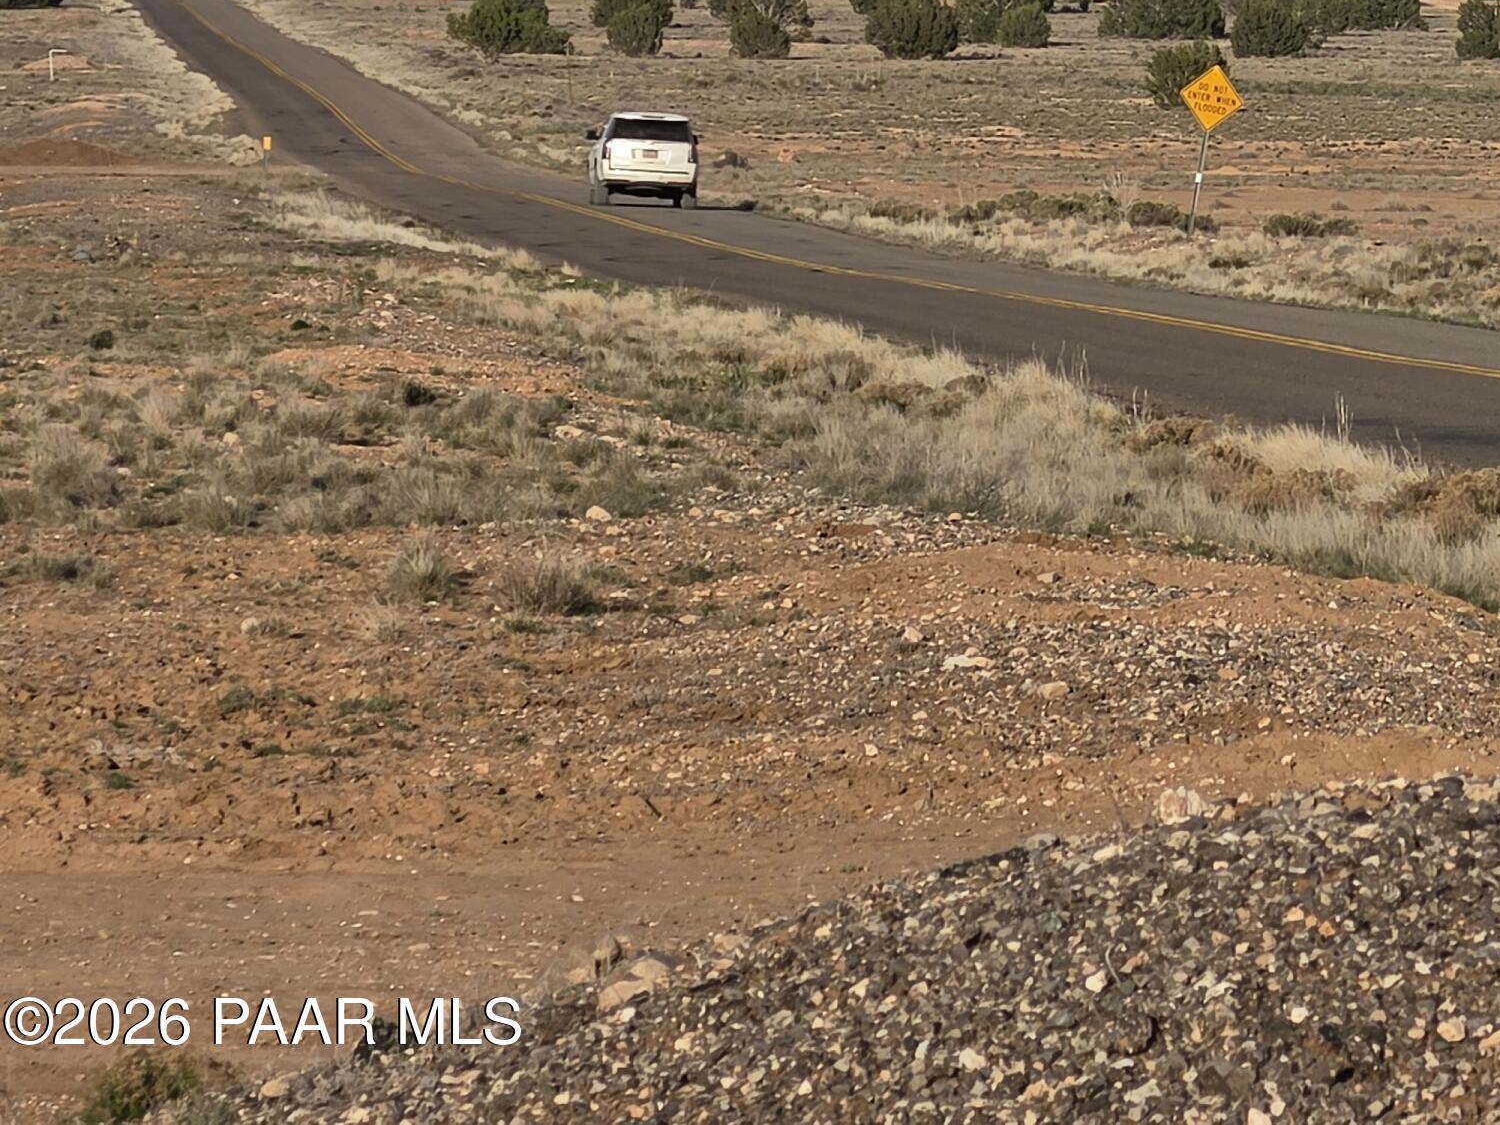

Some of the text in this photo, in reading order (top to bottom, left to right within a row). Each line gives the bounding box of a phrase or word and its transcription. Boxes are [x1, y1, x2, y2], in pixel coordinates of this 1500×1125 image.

[1199, 82, 1228, 94] DO NOT
[1187, 90, 1237, 107] ENTER WHEN
[1194, 101, 1226, 115] FLOODED
